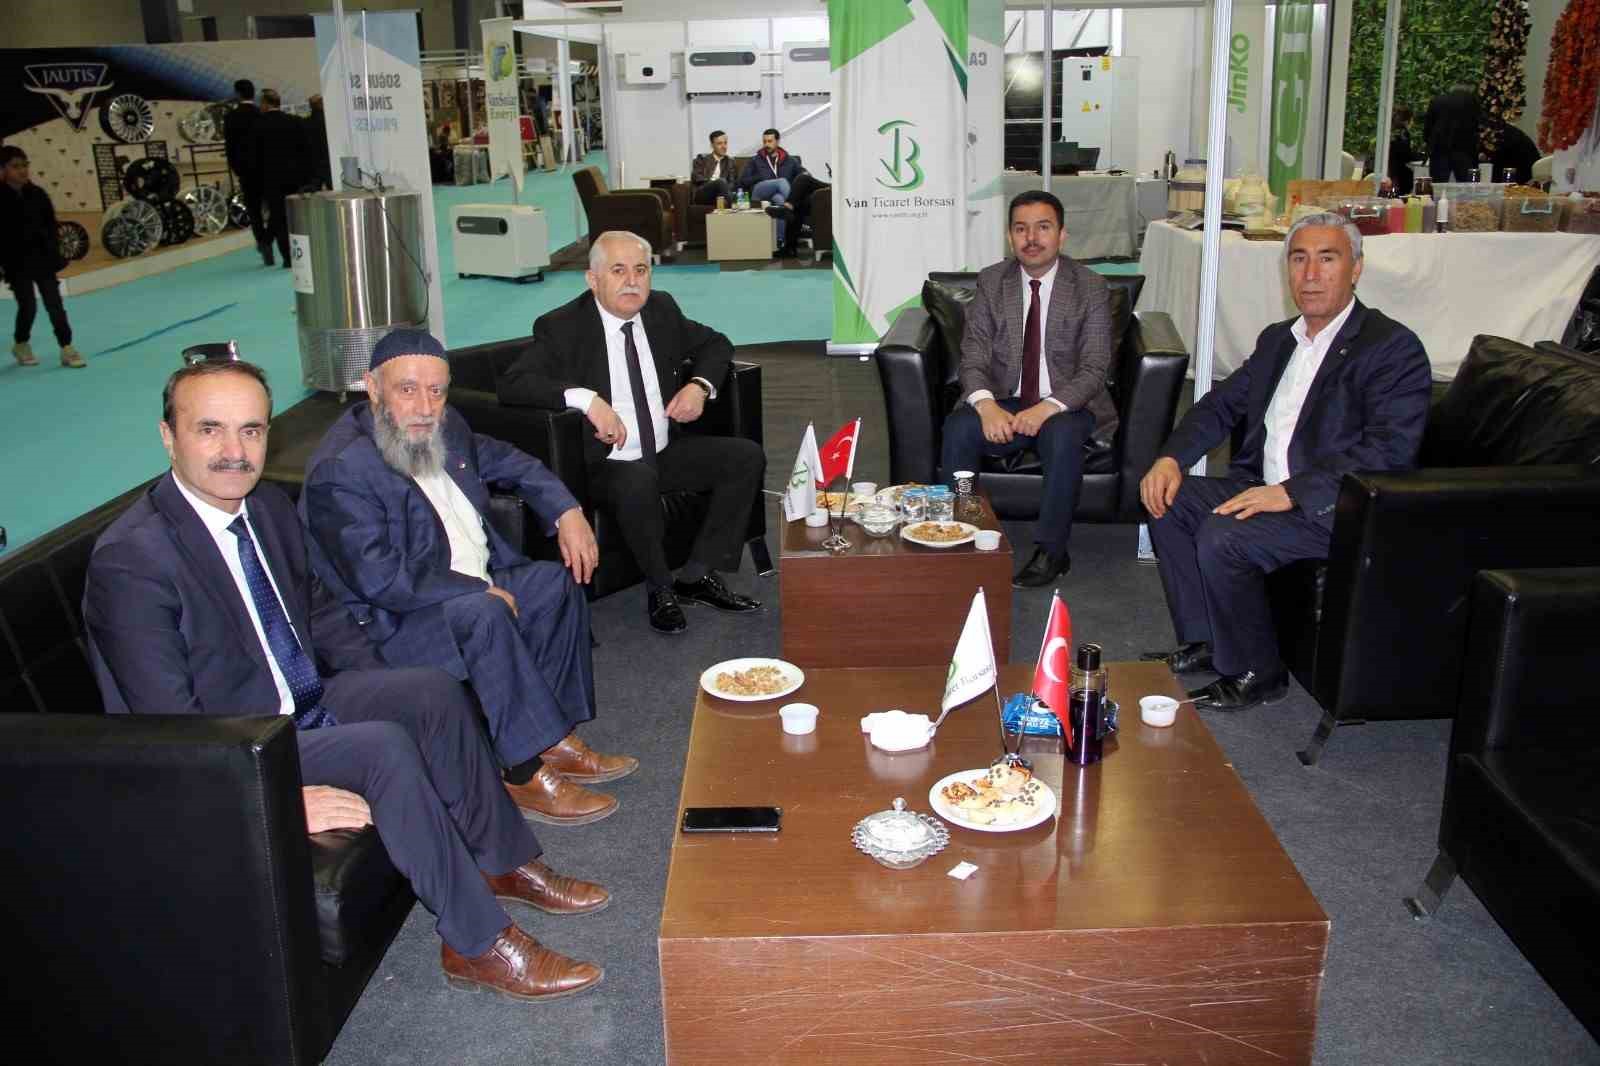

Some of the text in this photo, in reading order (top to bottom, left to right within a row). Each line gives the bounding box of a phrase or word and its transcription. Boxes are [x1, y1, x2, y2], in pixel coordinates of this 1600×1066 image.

[845, 196, 955, 208] Van Ticaret Borsası
